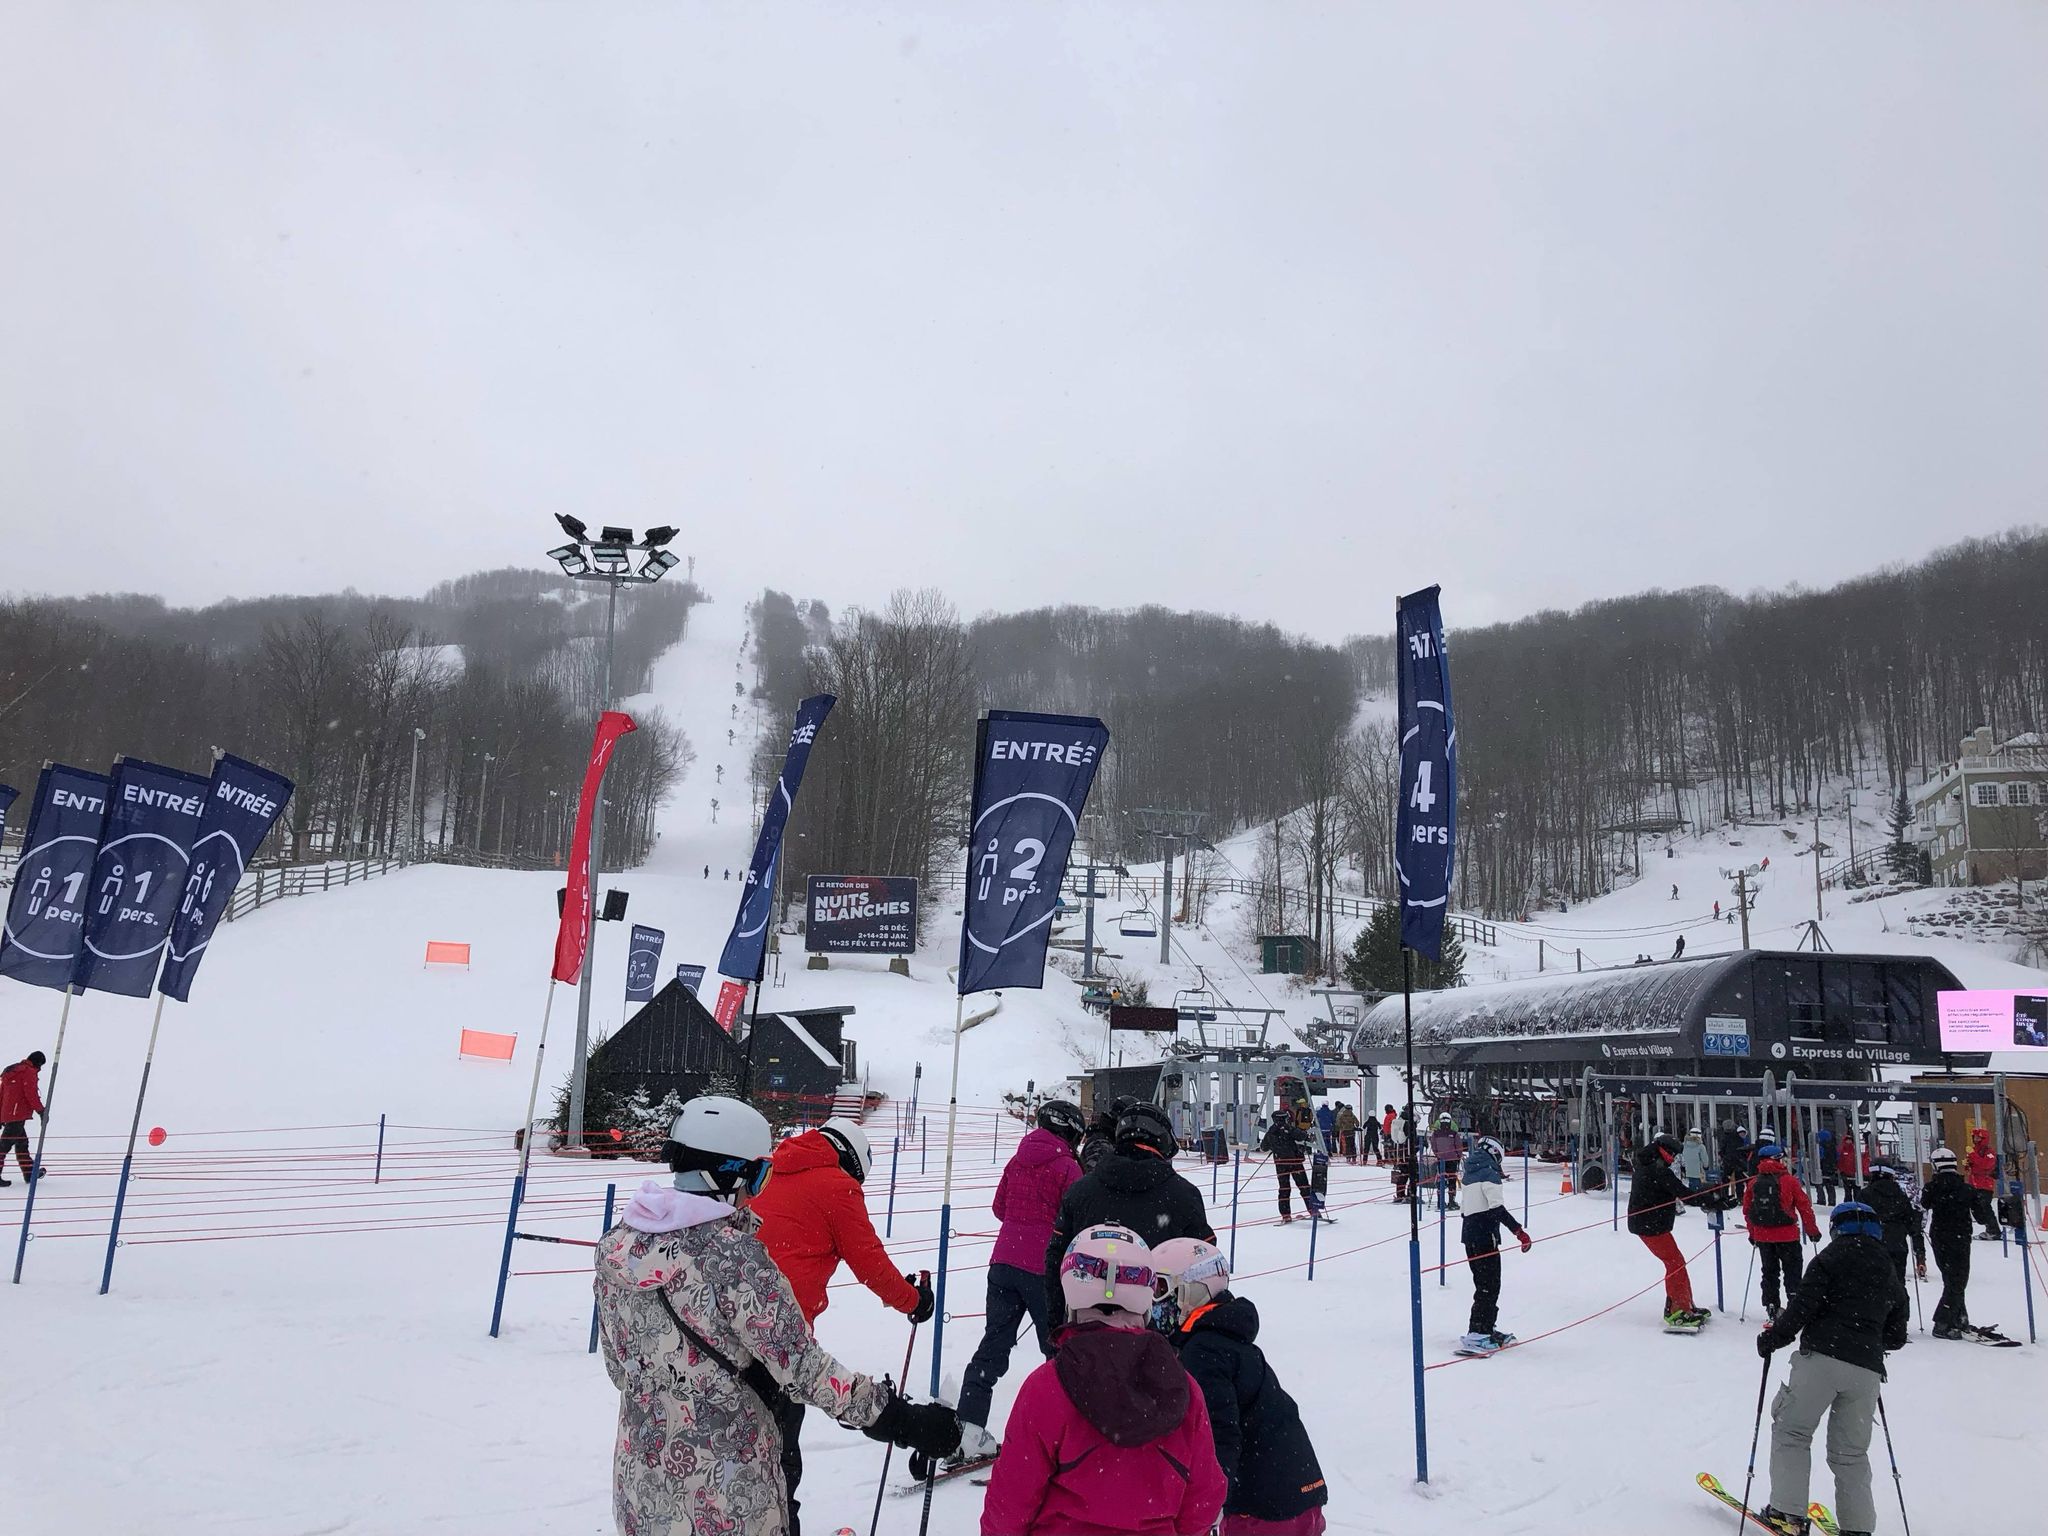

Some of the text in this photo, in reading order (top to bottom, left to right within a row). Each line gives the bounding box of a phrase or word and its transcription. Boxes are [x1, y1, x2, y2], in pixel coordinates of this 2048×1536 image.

[991, 740, 1096, 766] ENTRÉE
[1417, 760, 1436, 813] 4
[216, 781, 278, 818] ENTRÉE
[1010, 837, 1046, 881] 2
[63, 871, 85, 904] 1
[135, 871, 152, 904] 1
[815, 891, 869, 909] NUITS
[118, 907, 159, 926] pers.
[815, 901, 910, 922] BLANCHES
[891, 923, 909, 931] DÉC.
[851, 939, 868, 947] FÉV.
[1612, 1047, 1638, 1058] Express
[1639, 1046, 1648, 1055] du
[1648, 1044, 1674, 1057] Village
[1792, 1046, 1842, 1059] Express
[1846, 1048, 1862, 1059] du
[1866, 1048, 1911, 1062] Village
